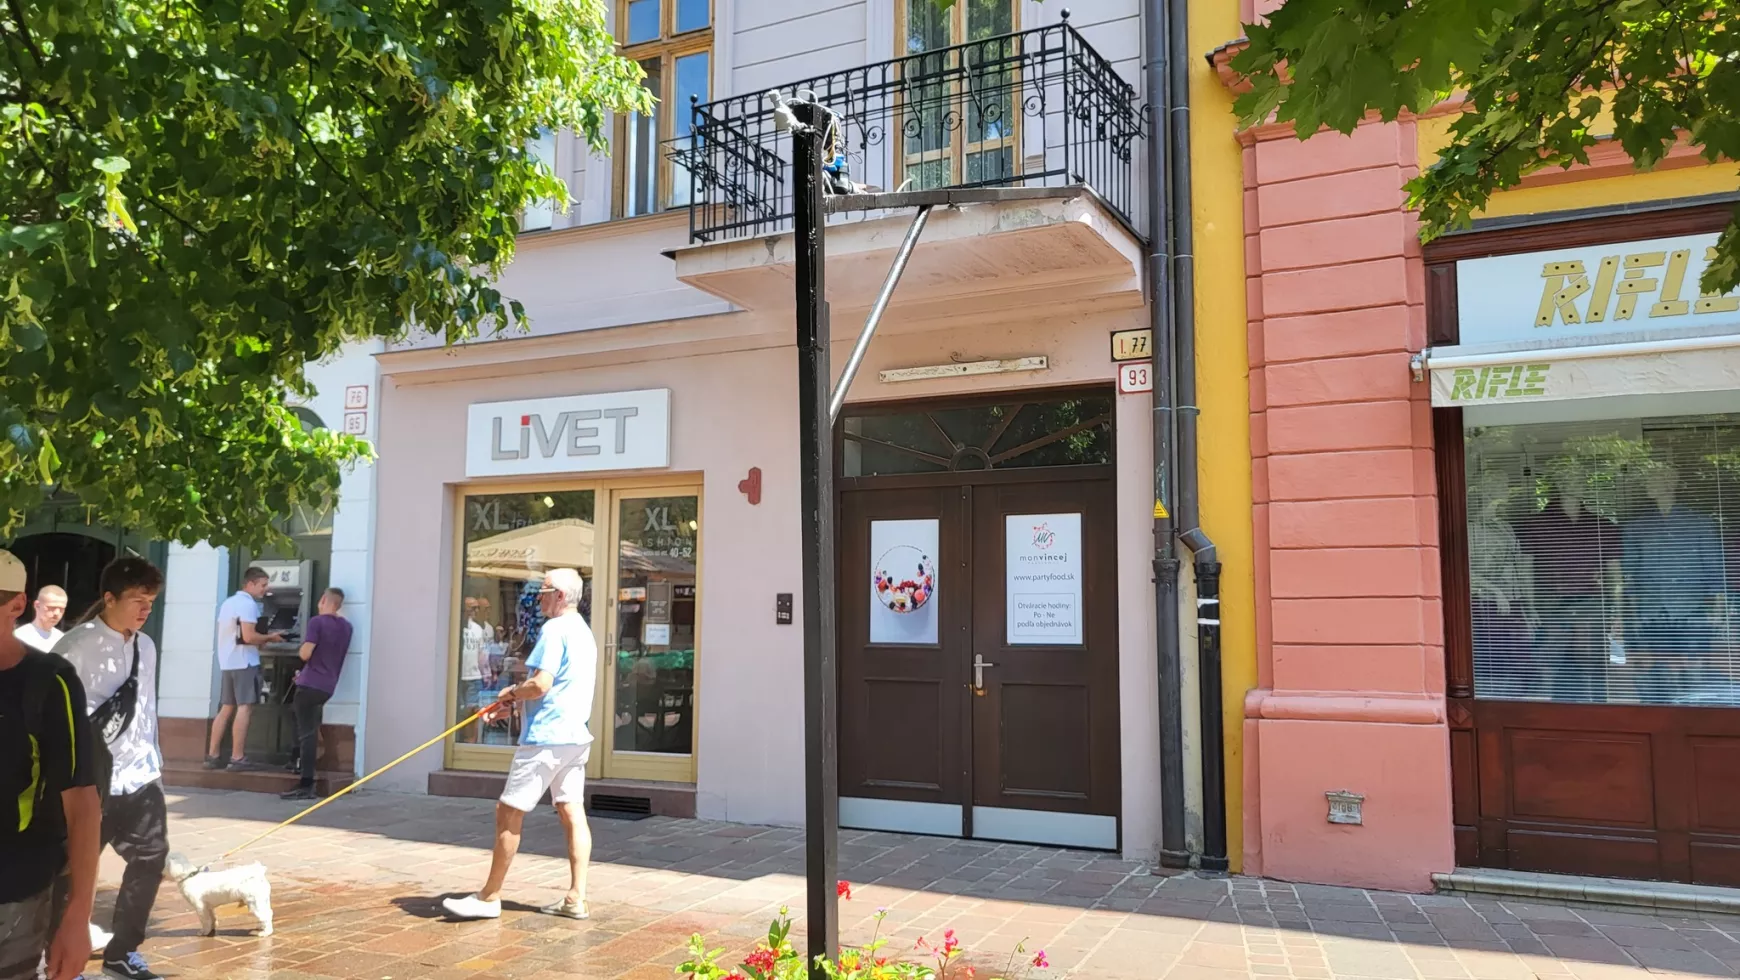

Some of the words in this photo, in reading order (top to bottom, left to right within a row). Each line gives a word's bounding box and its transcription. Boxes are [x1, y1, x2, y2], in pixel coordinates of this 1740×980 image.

[1131, 336, 1147, 353] 77
[1129, 369, 1147, 386] 93
[1450, 364, 1550, 400] RIFLE
[472, 500, 510, 531] XL
[644, 507, 677, 531] XL
[627, 537, 693, 548] ASHION
[1019, 553, 1067, 562] monvincej
[1013, 573, 1075, 582] www.partyfood.sk
